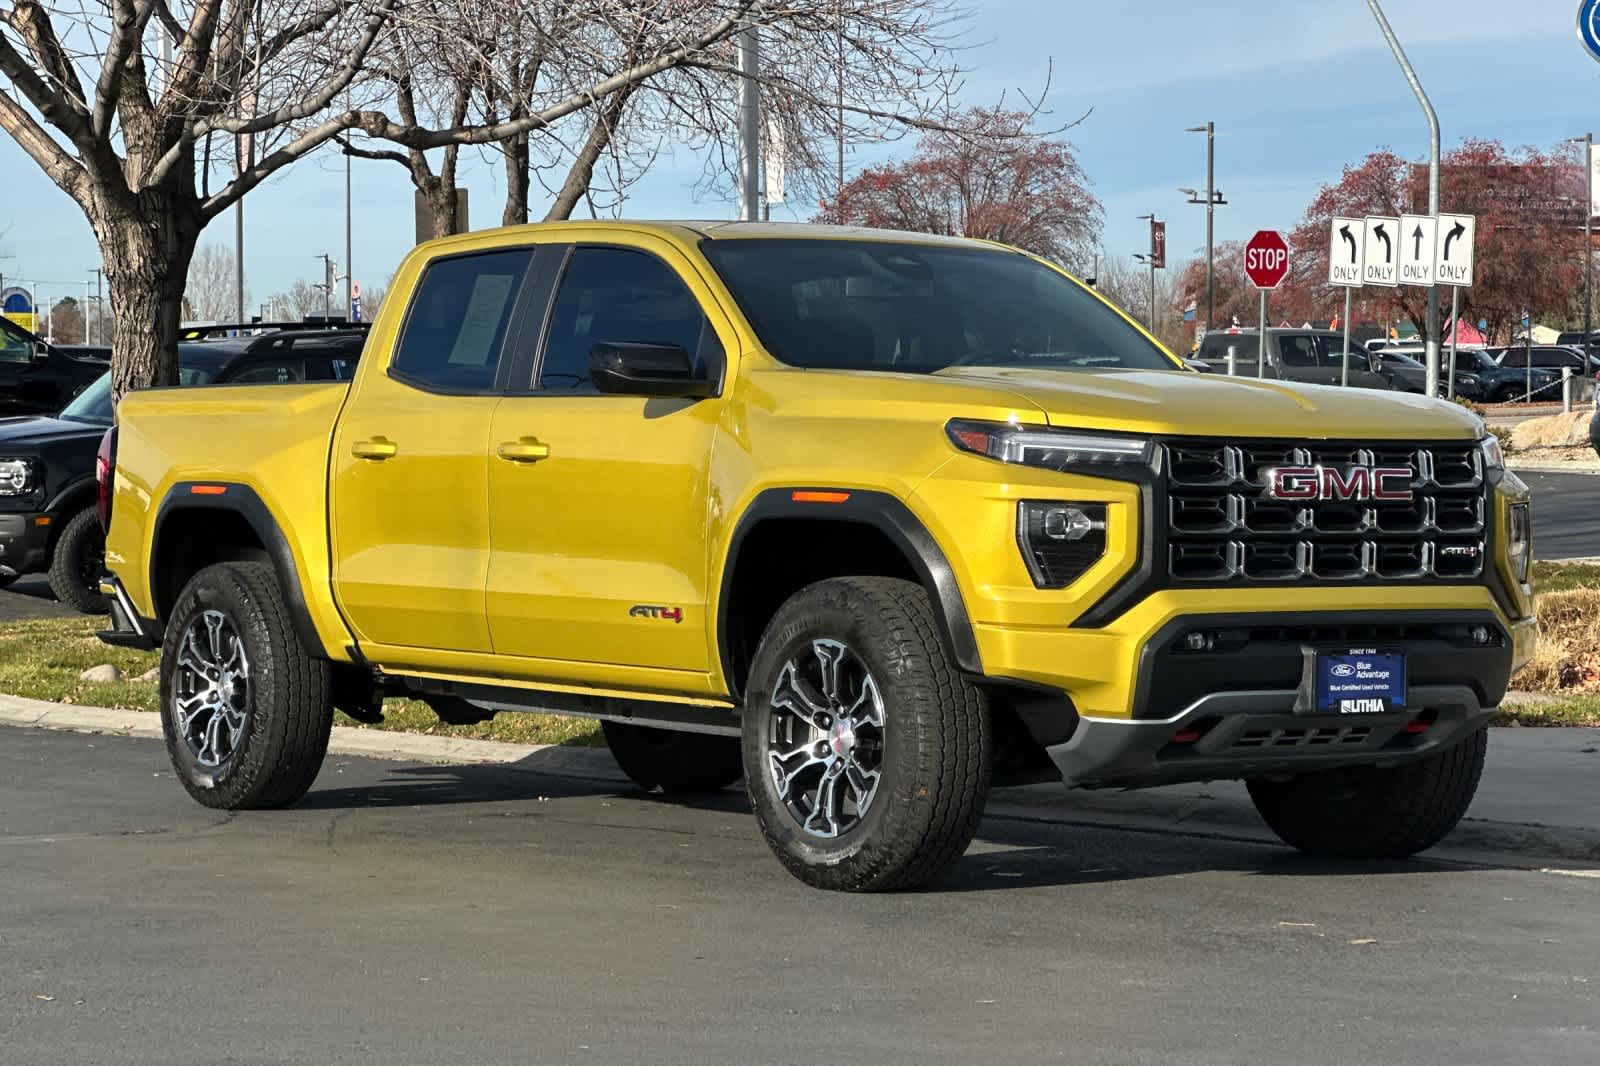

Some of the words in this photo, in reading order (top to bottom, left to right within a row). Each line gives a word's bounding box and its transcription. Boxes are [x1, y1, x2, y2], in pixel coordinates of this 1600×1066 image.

[1248, 248, 1285, 269] STOP
[1333, 266, 1358, 280] ONLY
[1368, 265, 1393, 280] ONLY
[1403, 264, 1429, 279] ONLY
[1439, 264, 1467, 280] ONLY
[1268, 466, 1413, 500] GMC
[1442, 547, 1477, 557] AT4
[629, 605, 683, 624] AT4
[1356, 661, 1372, 670] Blue
[1356, 671, 1390, 679] Advantage
[1351, 698, 1384, 713] LITHIA
